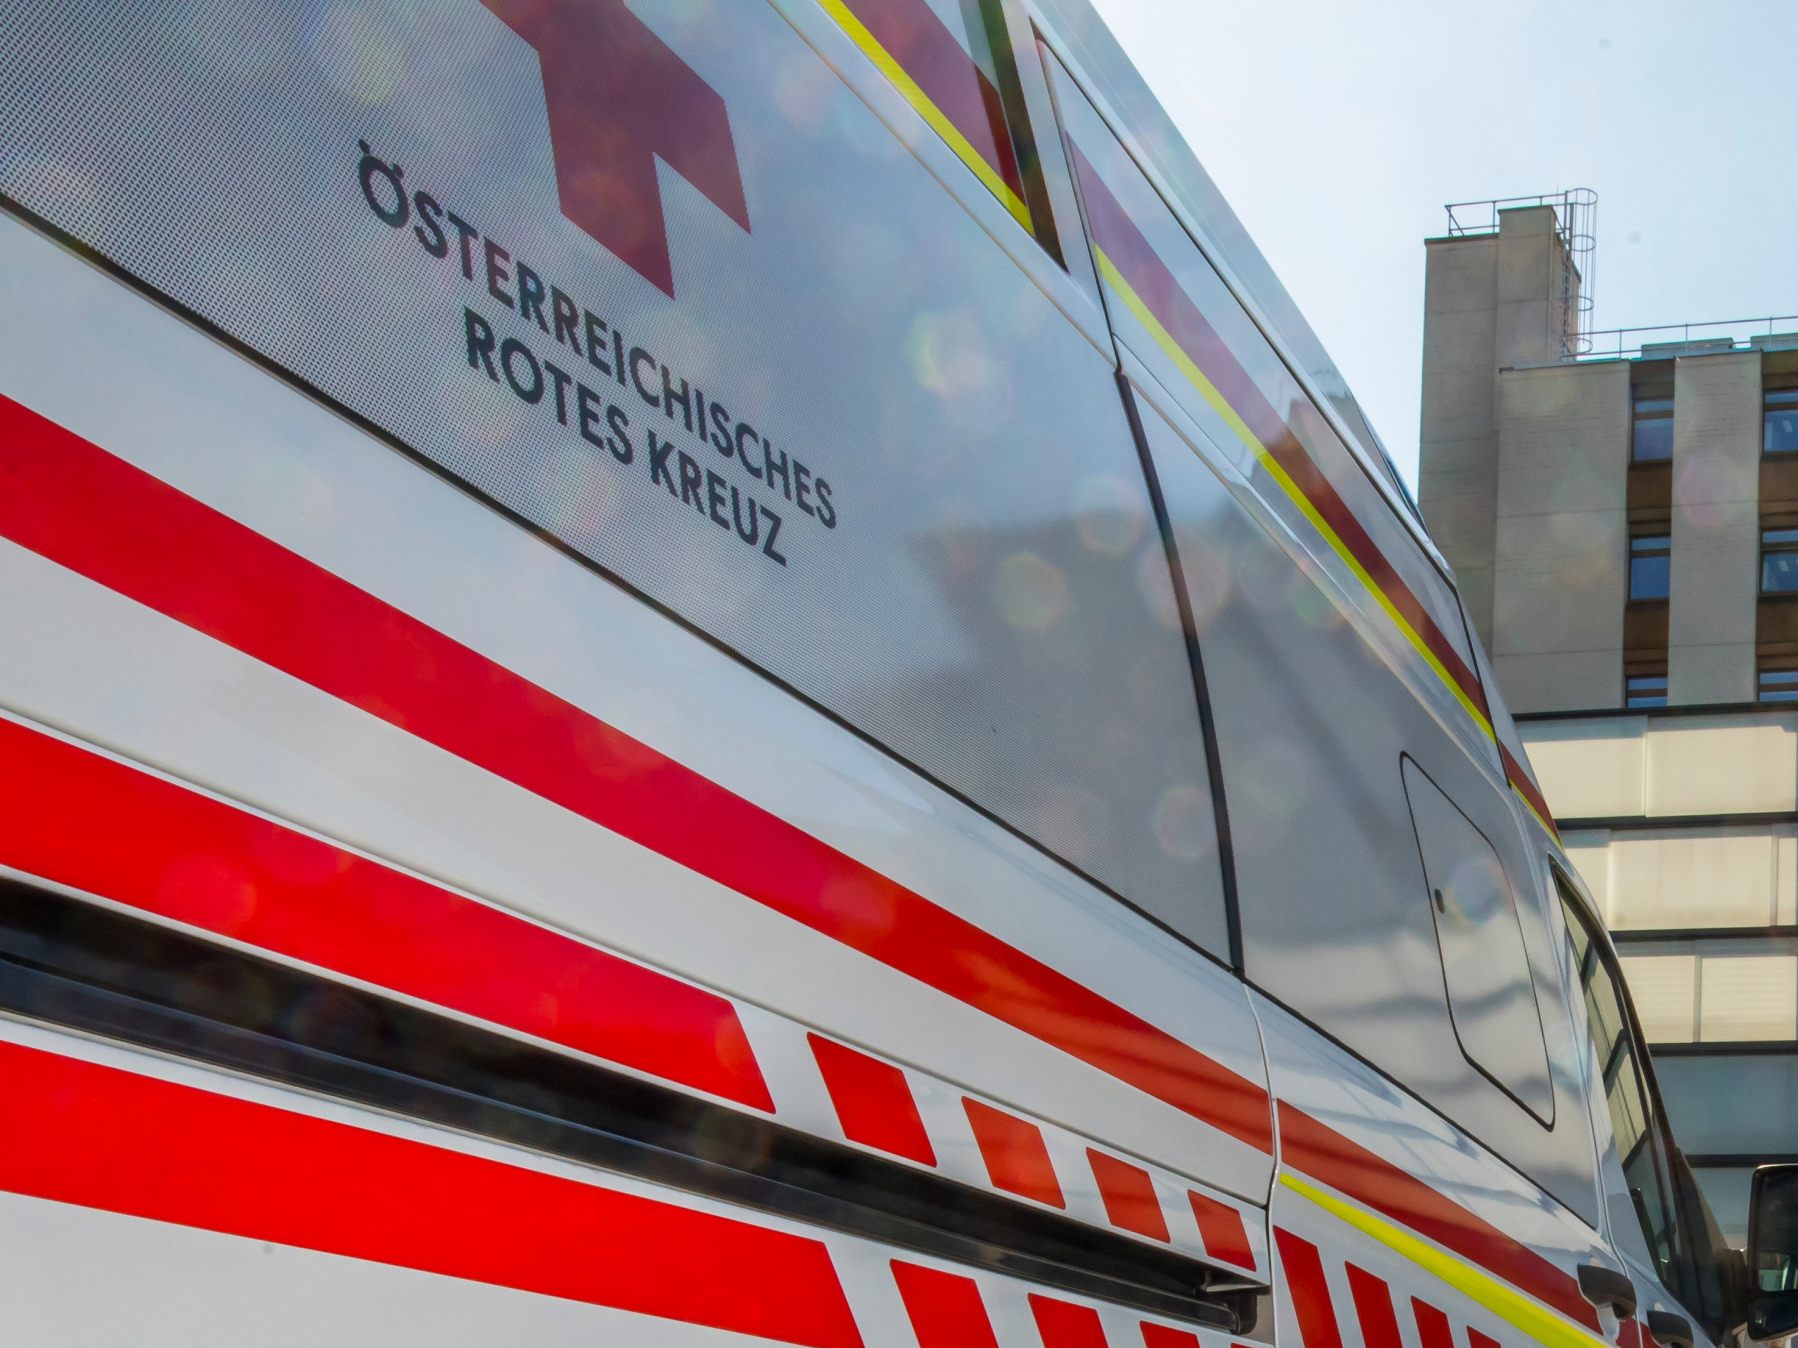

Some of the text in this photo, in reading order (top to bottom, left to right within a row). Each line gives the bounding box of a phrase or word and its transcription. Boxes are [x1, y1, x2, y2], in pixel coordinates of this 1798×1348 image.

[358, 139, 836, 529] ÖSTERREICHISCHES
[463, 306, 787, 567] ROTES KREUZ
